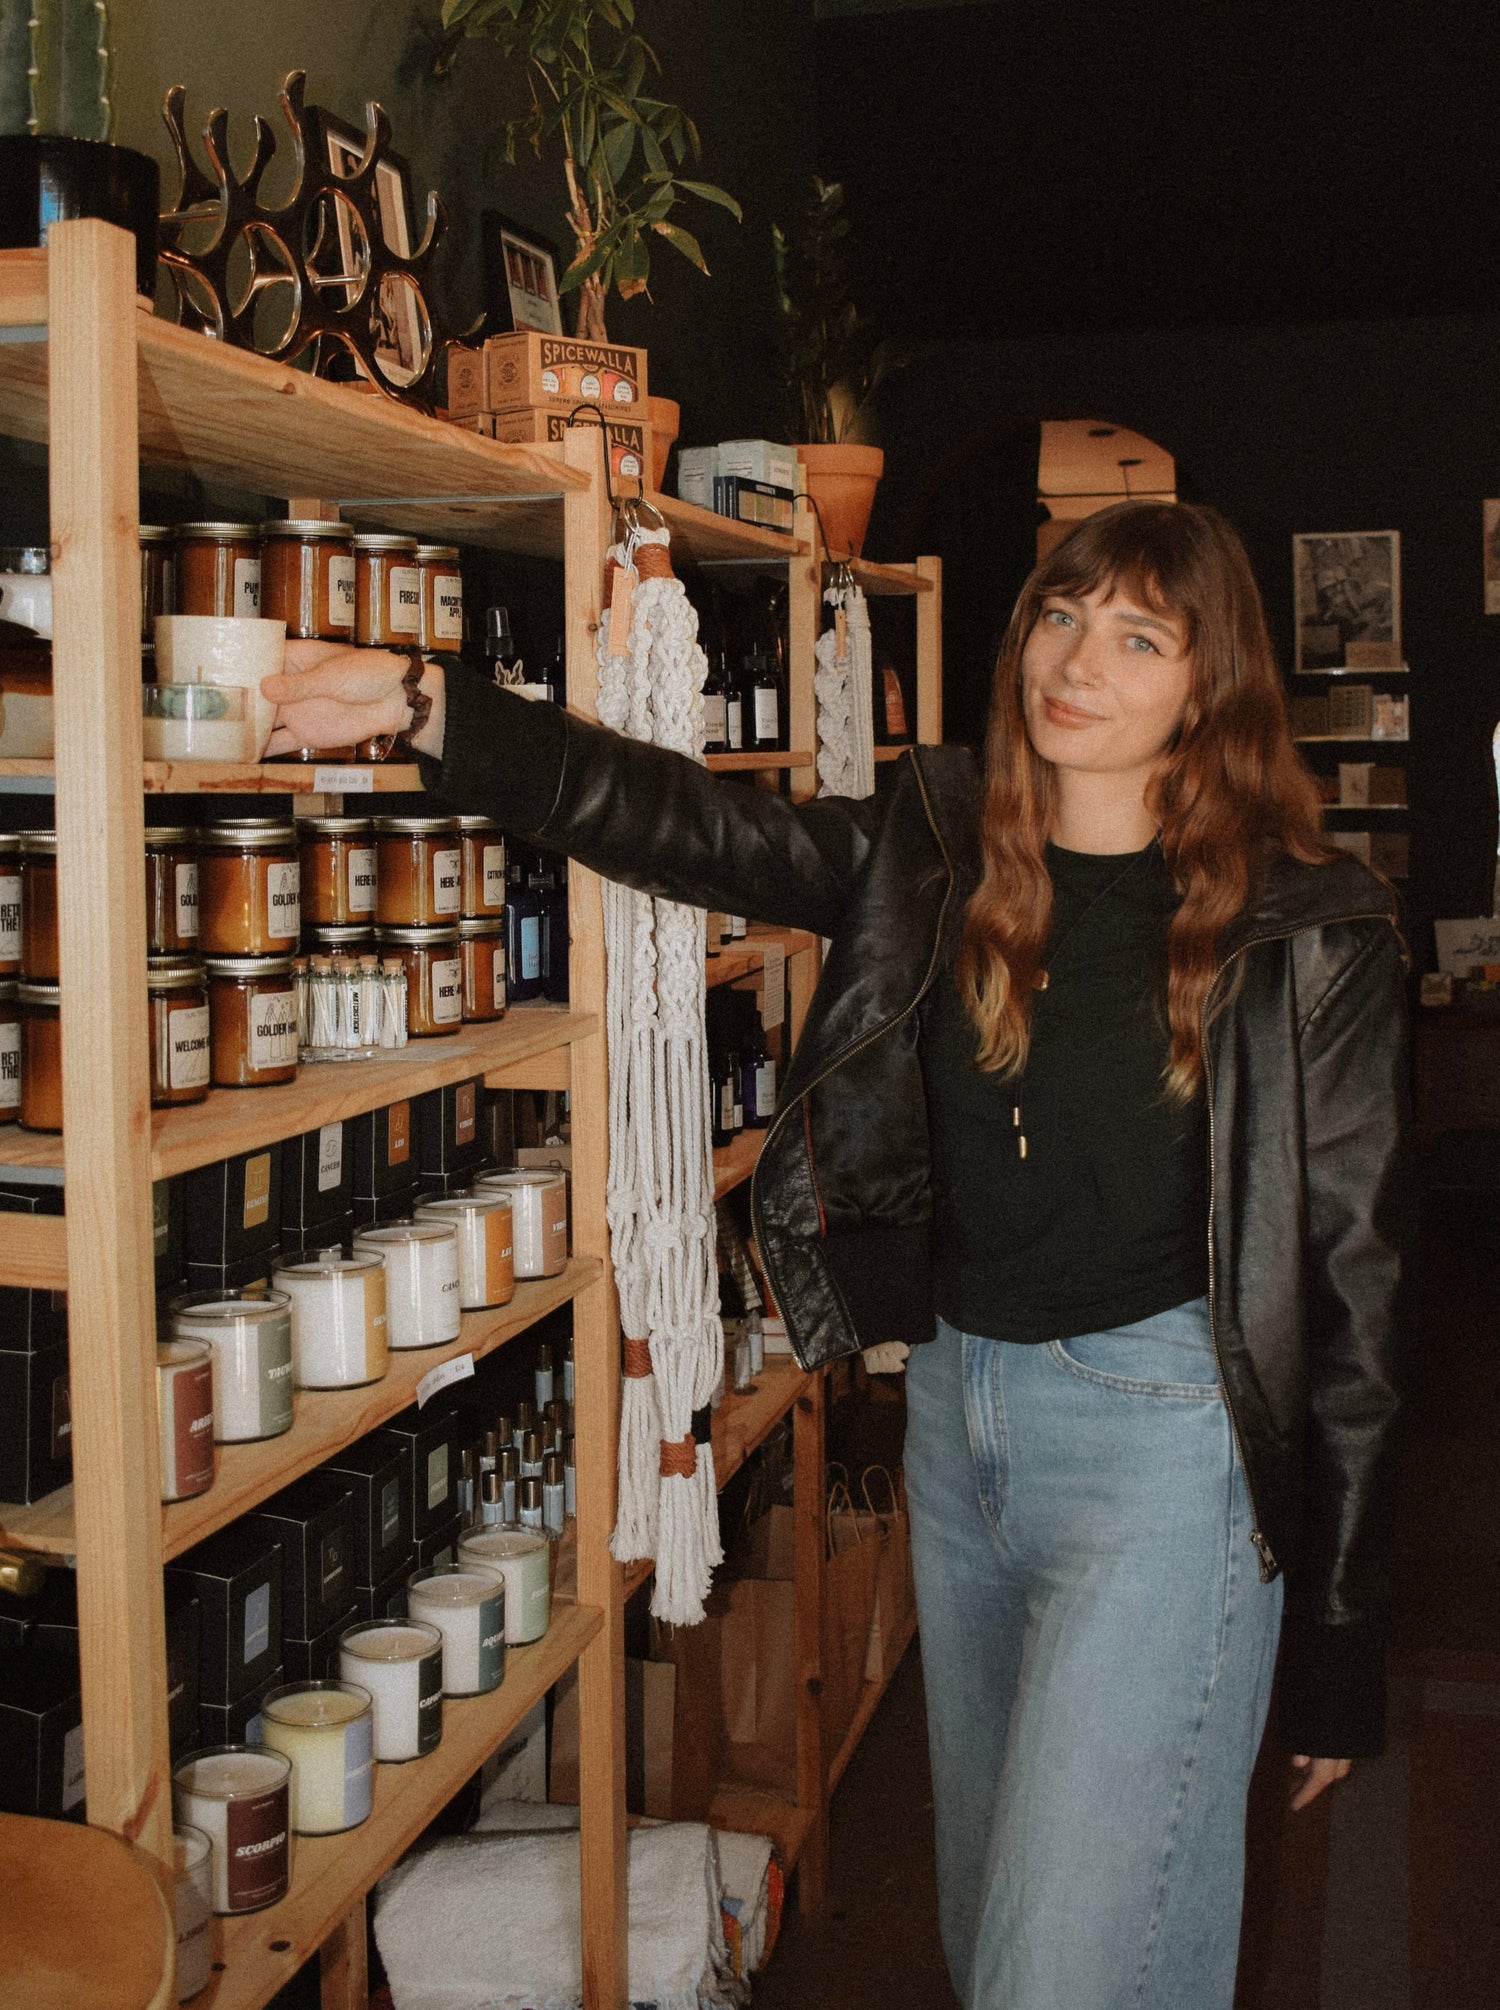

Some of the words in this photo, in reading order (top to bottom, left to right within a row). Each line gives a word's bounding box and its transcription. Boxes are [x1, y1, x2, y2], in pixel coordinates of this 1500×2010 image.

[543, 341, 634, 377] SPICEWALLA
[354, 875, 371, 886] HERE
[440, 876, 455, 889] HERE
[272, 892, 296, 906] GOLDEN
[438, 985, 455, 998] HERE
[256, 1021, 287, 1037] GOLDEN
[175, 1037, 206, 1053] WELCOME
[320, 1160, 341, 1174] CANCER
[235, 1831, 286, 1858] SCORPIO
